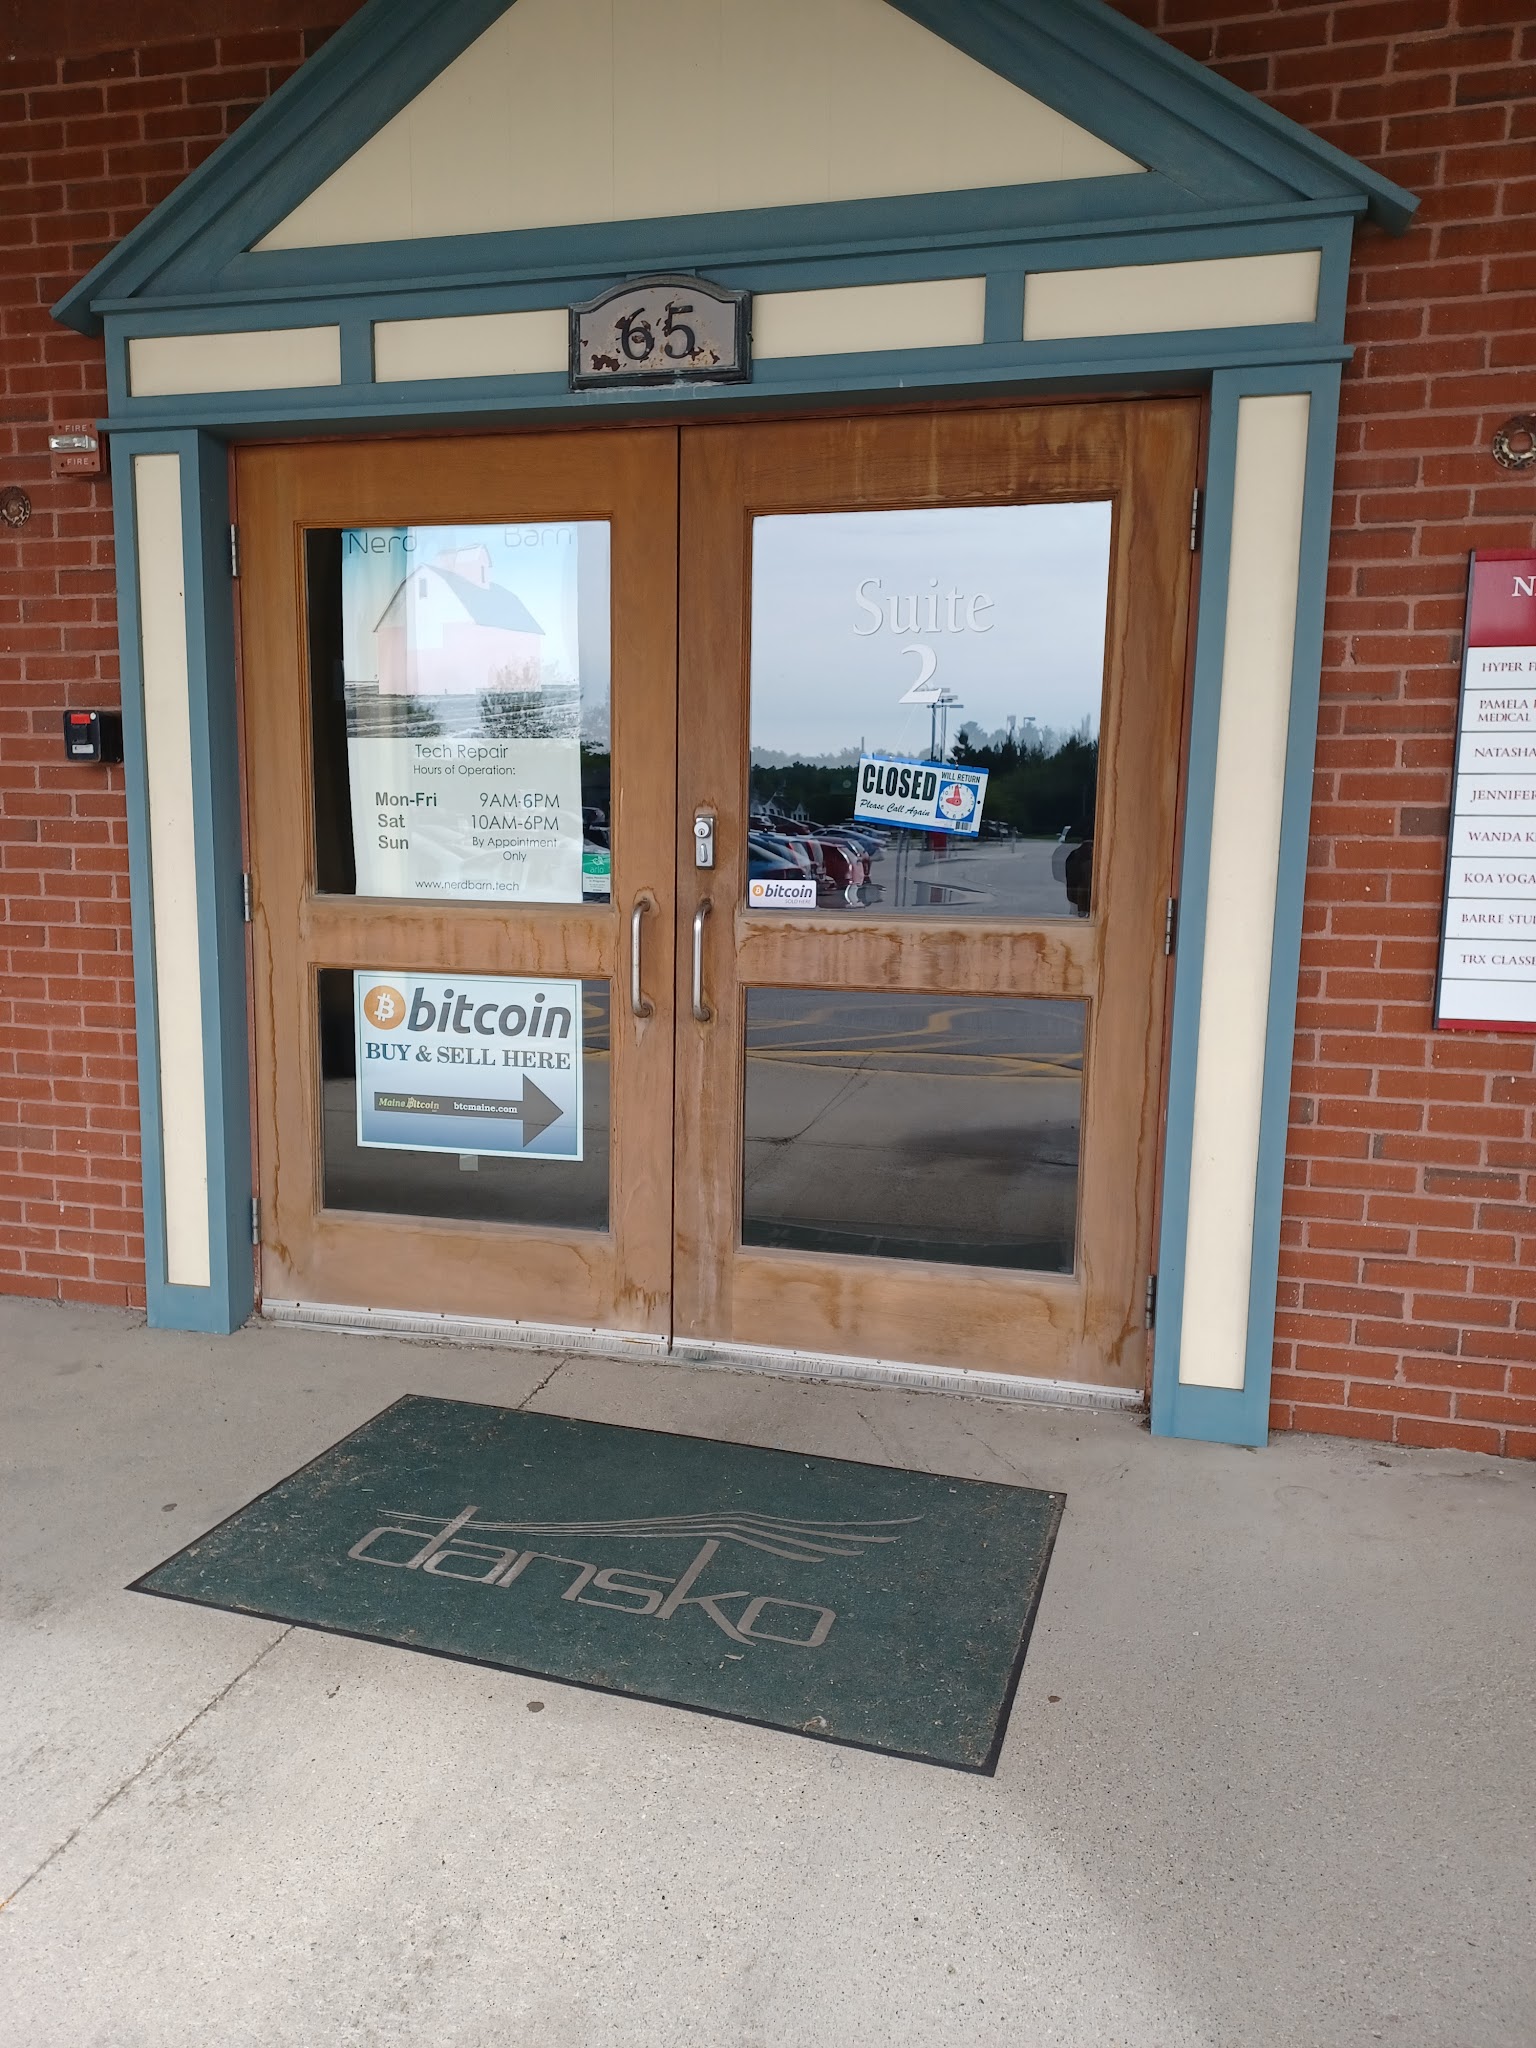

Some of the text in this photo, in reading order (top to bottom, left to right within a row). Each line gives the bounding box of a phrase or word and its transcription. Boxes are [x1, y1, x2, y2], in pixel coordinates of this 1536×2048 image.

[620, 302, 696, 361] 65
[65, 424, 88, 432] FIRE
[66, 457, 89, 466] FIRE
[348, 526, 573, 554] Nerd Barn
[1511, 575, 1536, 597] N
[853, 577, 996, 636] Suite
[898, 643, 944, 704] 2
[1481, 662, 1523, 673] HYPER
[1479, 699, 1529, 709] PAMELA
[1477, 712, 1531, 723] MEDICAL
[415, 744, 509, 762] Tech Repair
[1474, 747, 1536, 758] NATASHA
[413, 765, 516, 777] Hours of Operation:
[941, 771, 981, 784] WILL RETURN
[862, 763, 937, 801] CLOSED
[375, 791, 560, 809] Mon-Fri 9AM-6PM
[859, 799, 930, 818] Please Call Again
[377, 813, 560, 831] Sat 10AM-6PM
[378, 834, 557, 850] Sun By Appointment
[1468, 831, 1536, 842] WANDA K
[502, 851, 527, 863] Only
[1464, 872, 1536, 884] KOA YOGA
[414, 880, 520, 892] www.nerdbarn.tech
[764, 883, 813, 898] bitcoin
[1461, 913, 1536, 925] BARRE STU
[1460, 953, 1486, 964] TRX
[406, 986, 572, 1039] bitcoin
[365, 1042, 571, 1070] BUY & SELL HERE
[378, 1097, 406, 1108] Maine
[453, 1101, 518, 1114] btcmaine.com
[347, 1505, 837, 1648] dansko
